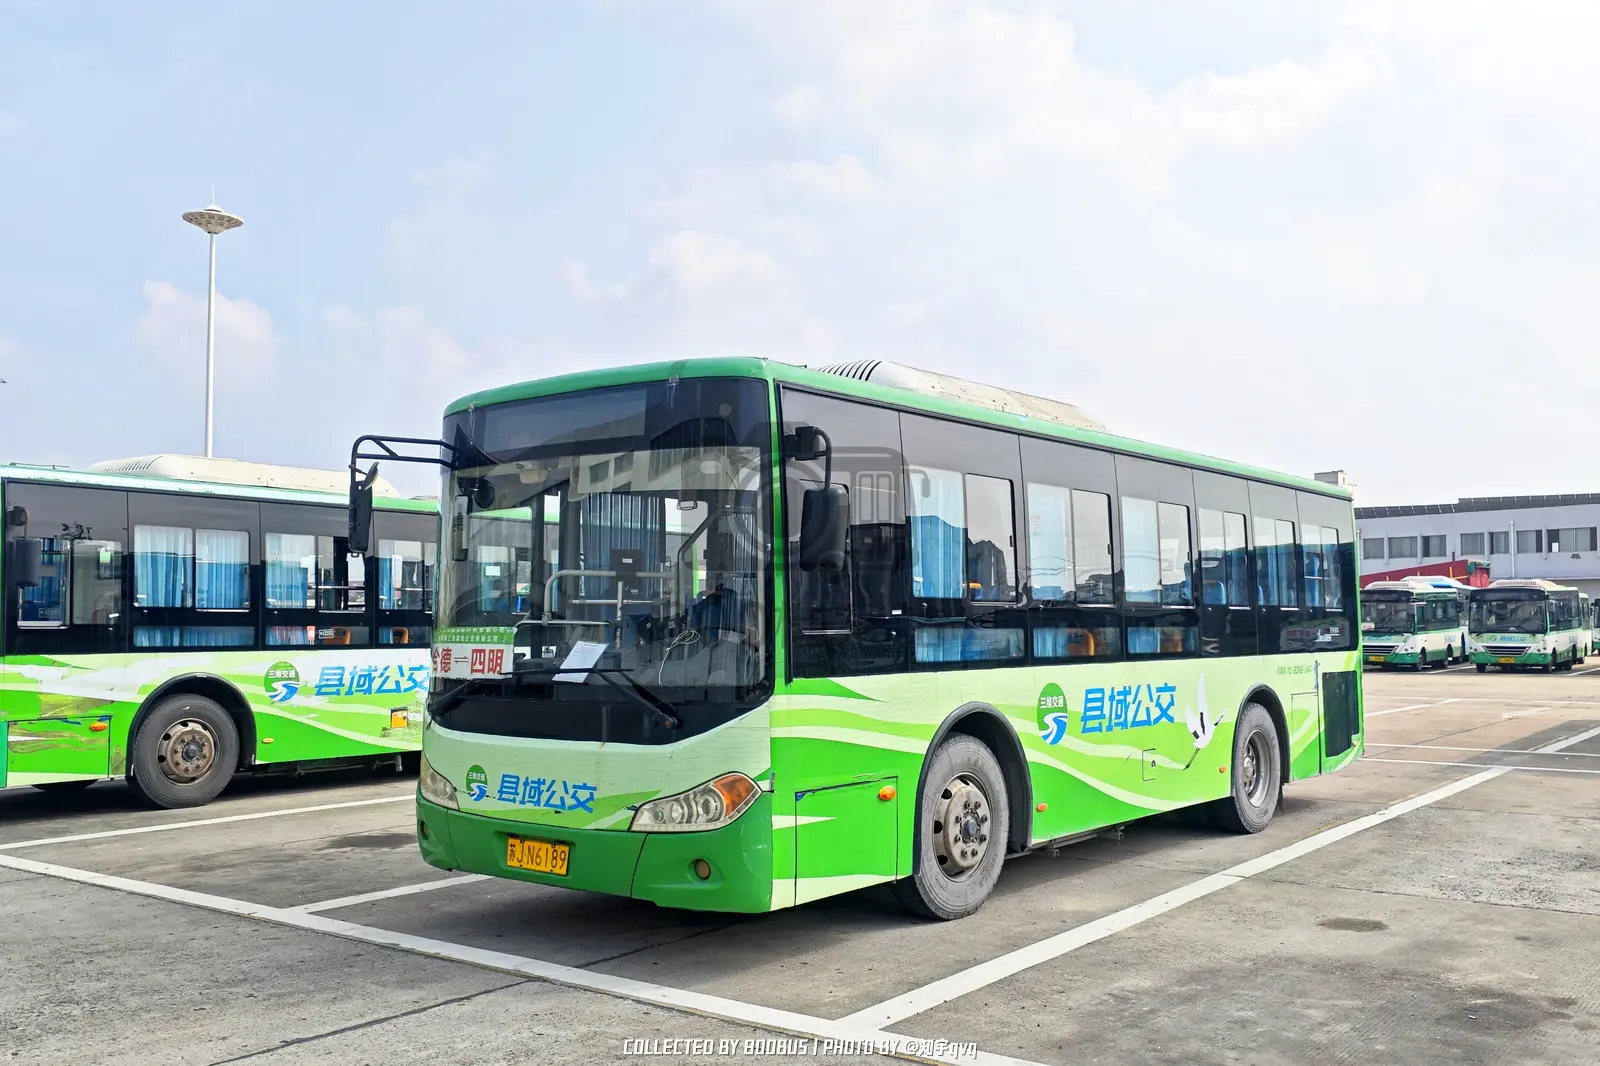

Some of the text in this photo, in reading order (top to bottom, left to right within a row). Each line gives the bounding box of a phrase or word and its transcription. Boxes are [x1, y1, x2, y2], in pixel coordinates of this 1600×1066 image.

[471, 648, 504, 674] 四明
[314, 664, 430, 696] 县域公交
[1080, 682, 1176, 733] 县域公交
[497, 773, 597, 814] 县域公交
